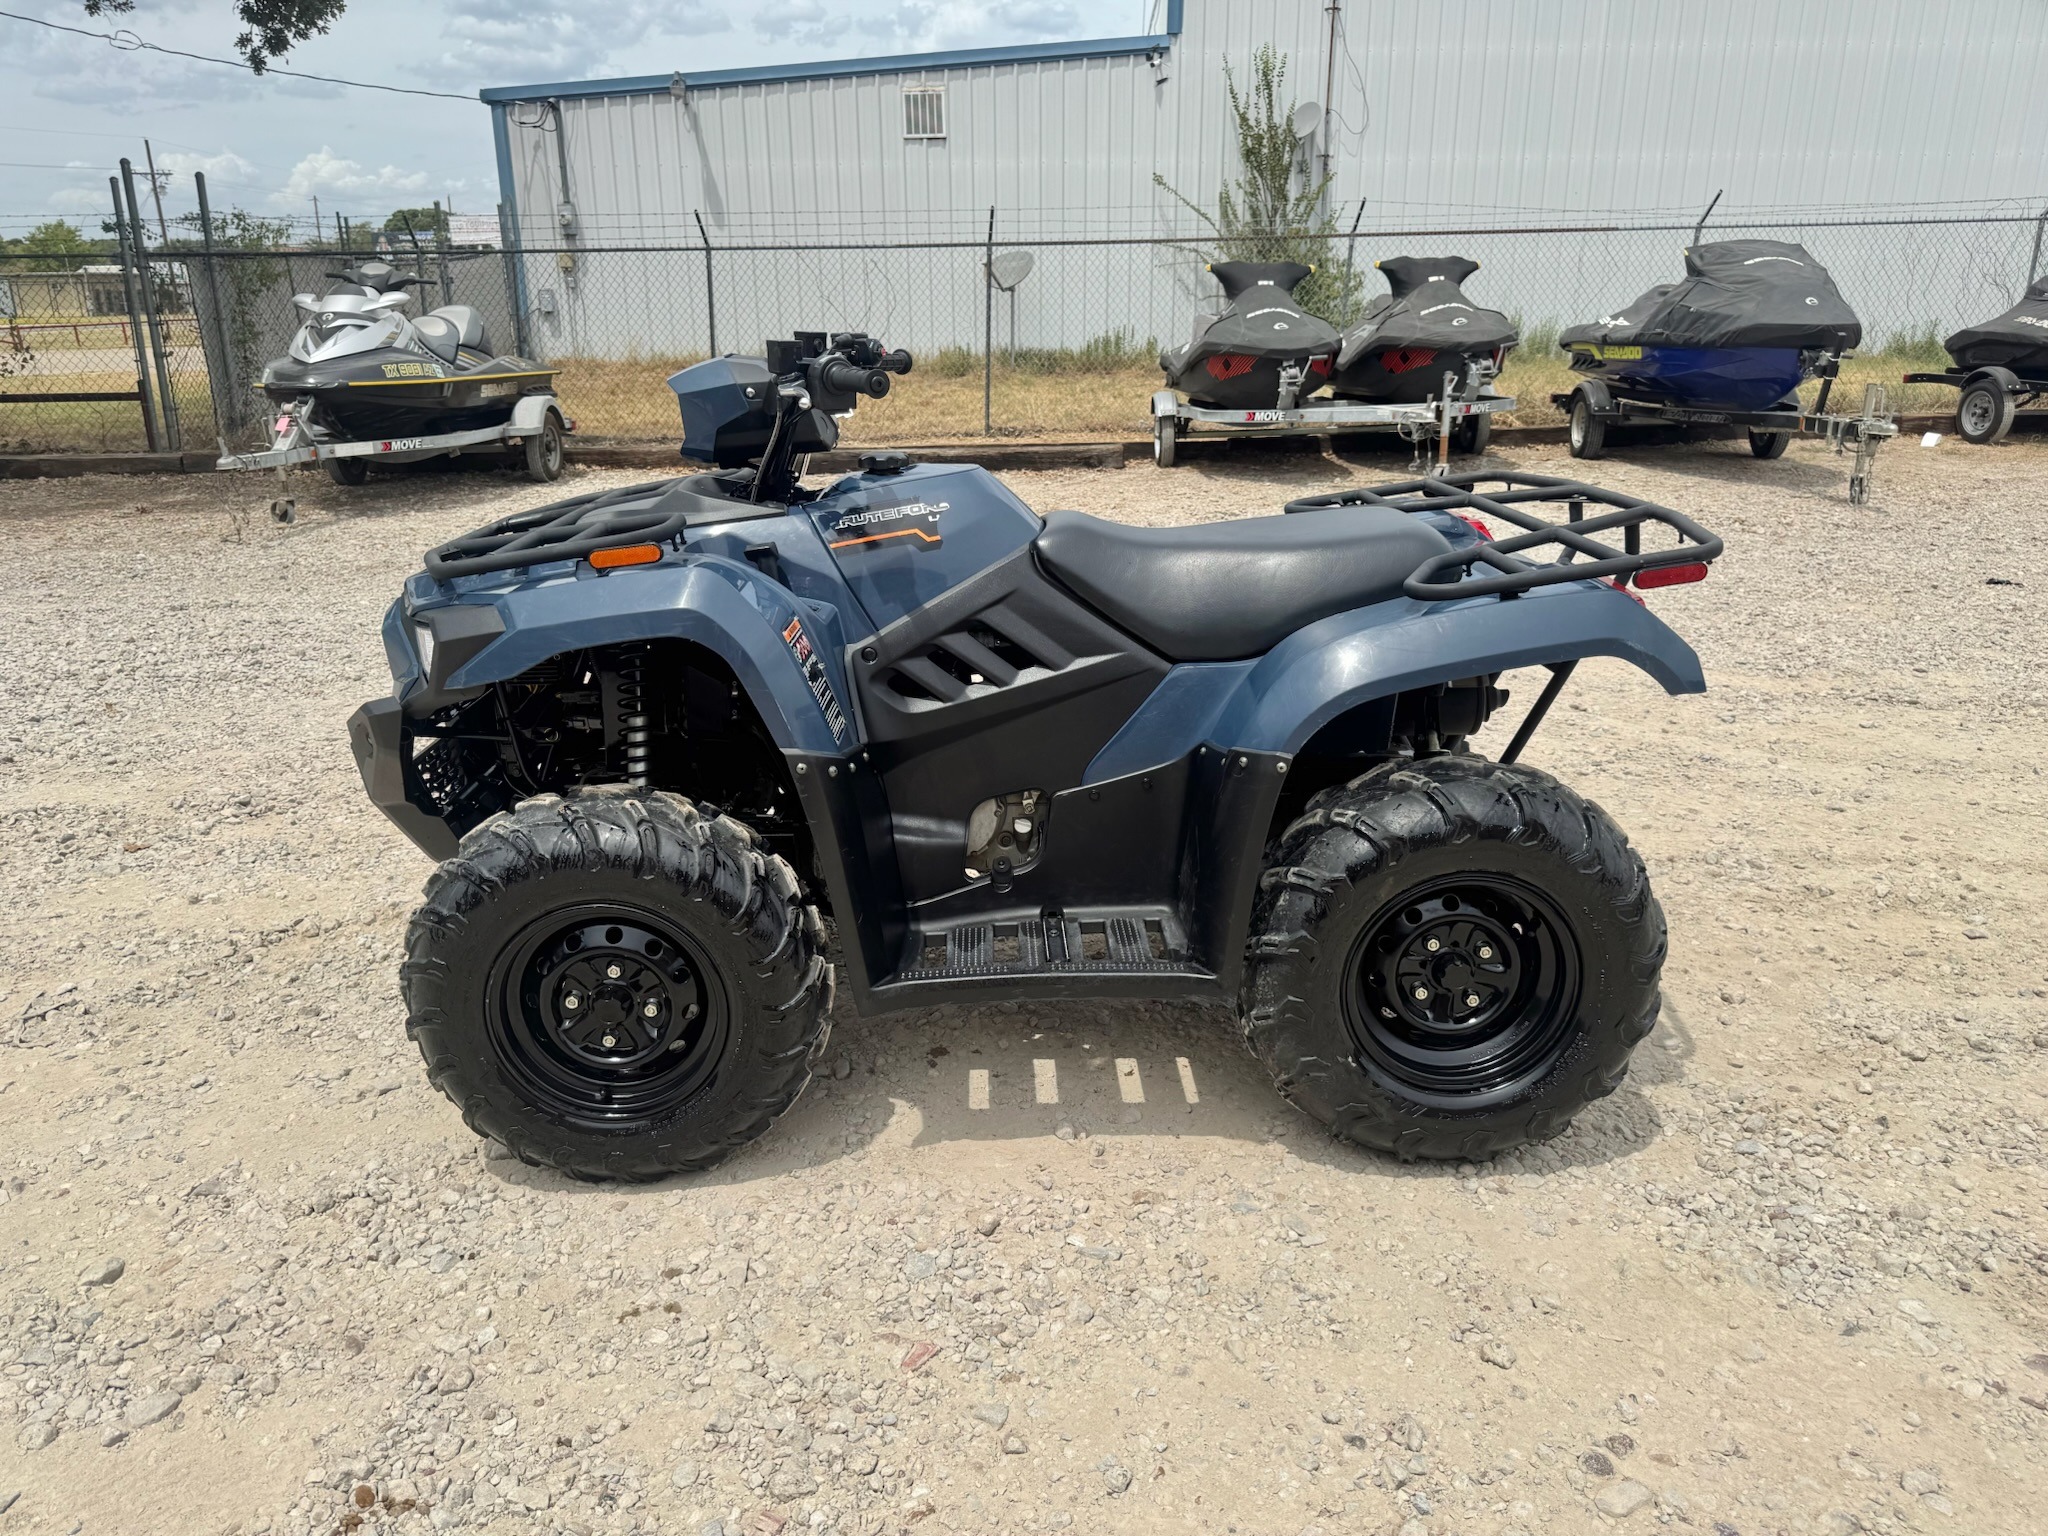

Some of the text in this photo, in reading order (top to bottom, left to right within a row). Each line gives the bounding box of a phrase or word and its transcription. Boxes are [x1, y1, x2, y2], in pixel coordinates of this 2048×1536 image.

[381, 363, 400, 378] TX
[1470, 403, 1490, 413] MOVE
[1254, 411, 1286, 421] MOVE
[391, 439, 422, 450] MOVE
